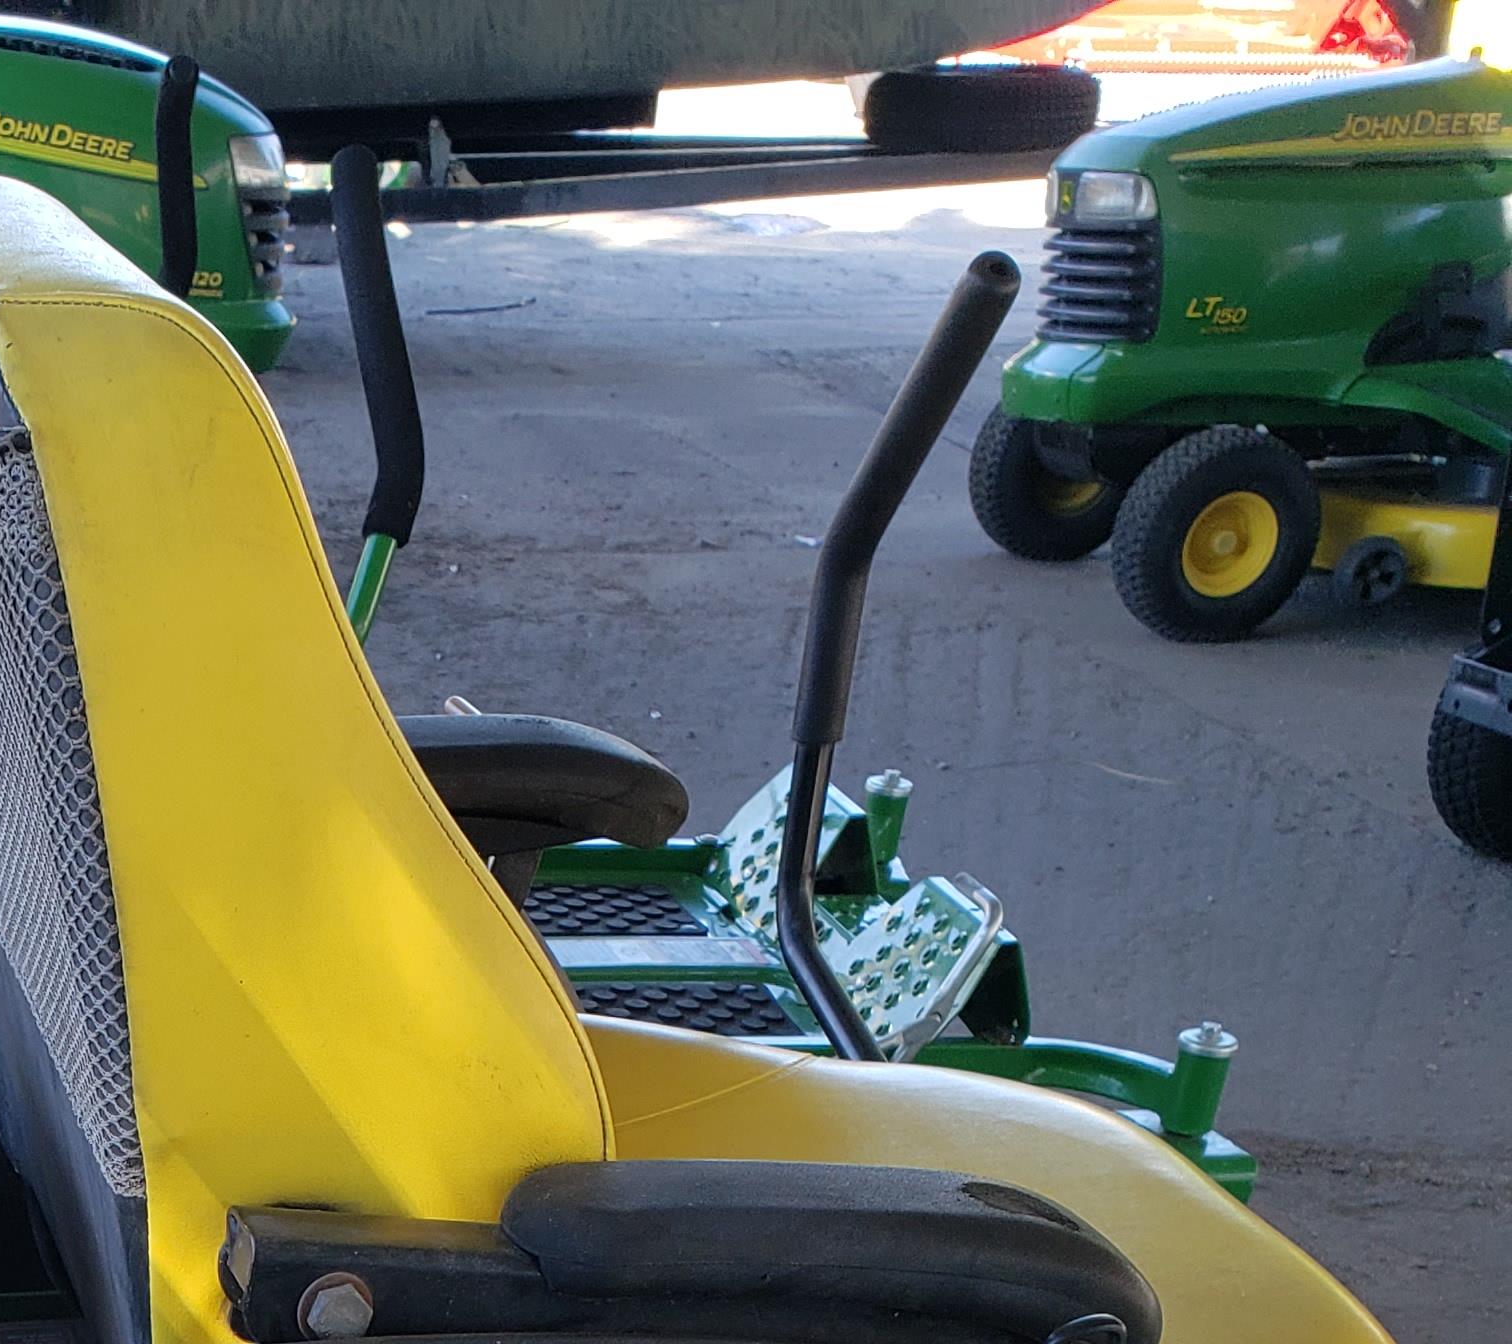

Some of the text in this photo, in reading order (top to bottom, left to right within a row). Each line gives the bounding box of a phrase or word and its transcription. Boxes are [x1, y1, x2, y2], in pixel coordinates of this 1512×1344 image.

[1334, 109, 1503, 141] JOHN DEERE
[50, 124, 134, 161] DEERE
